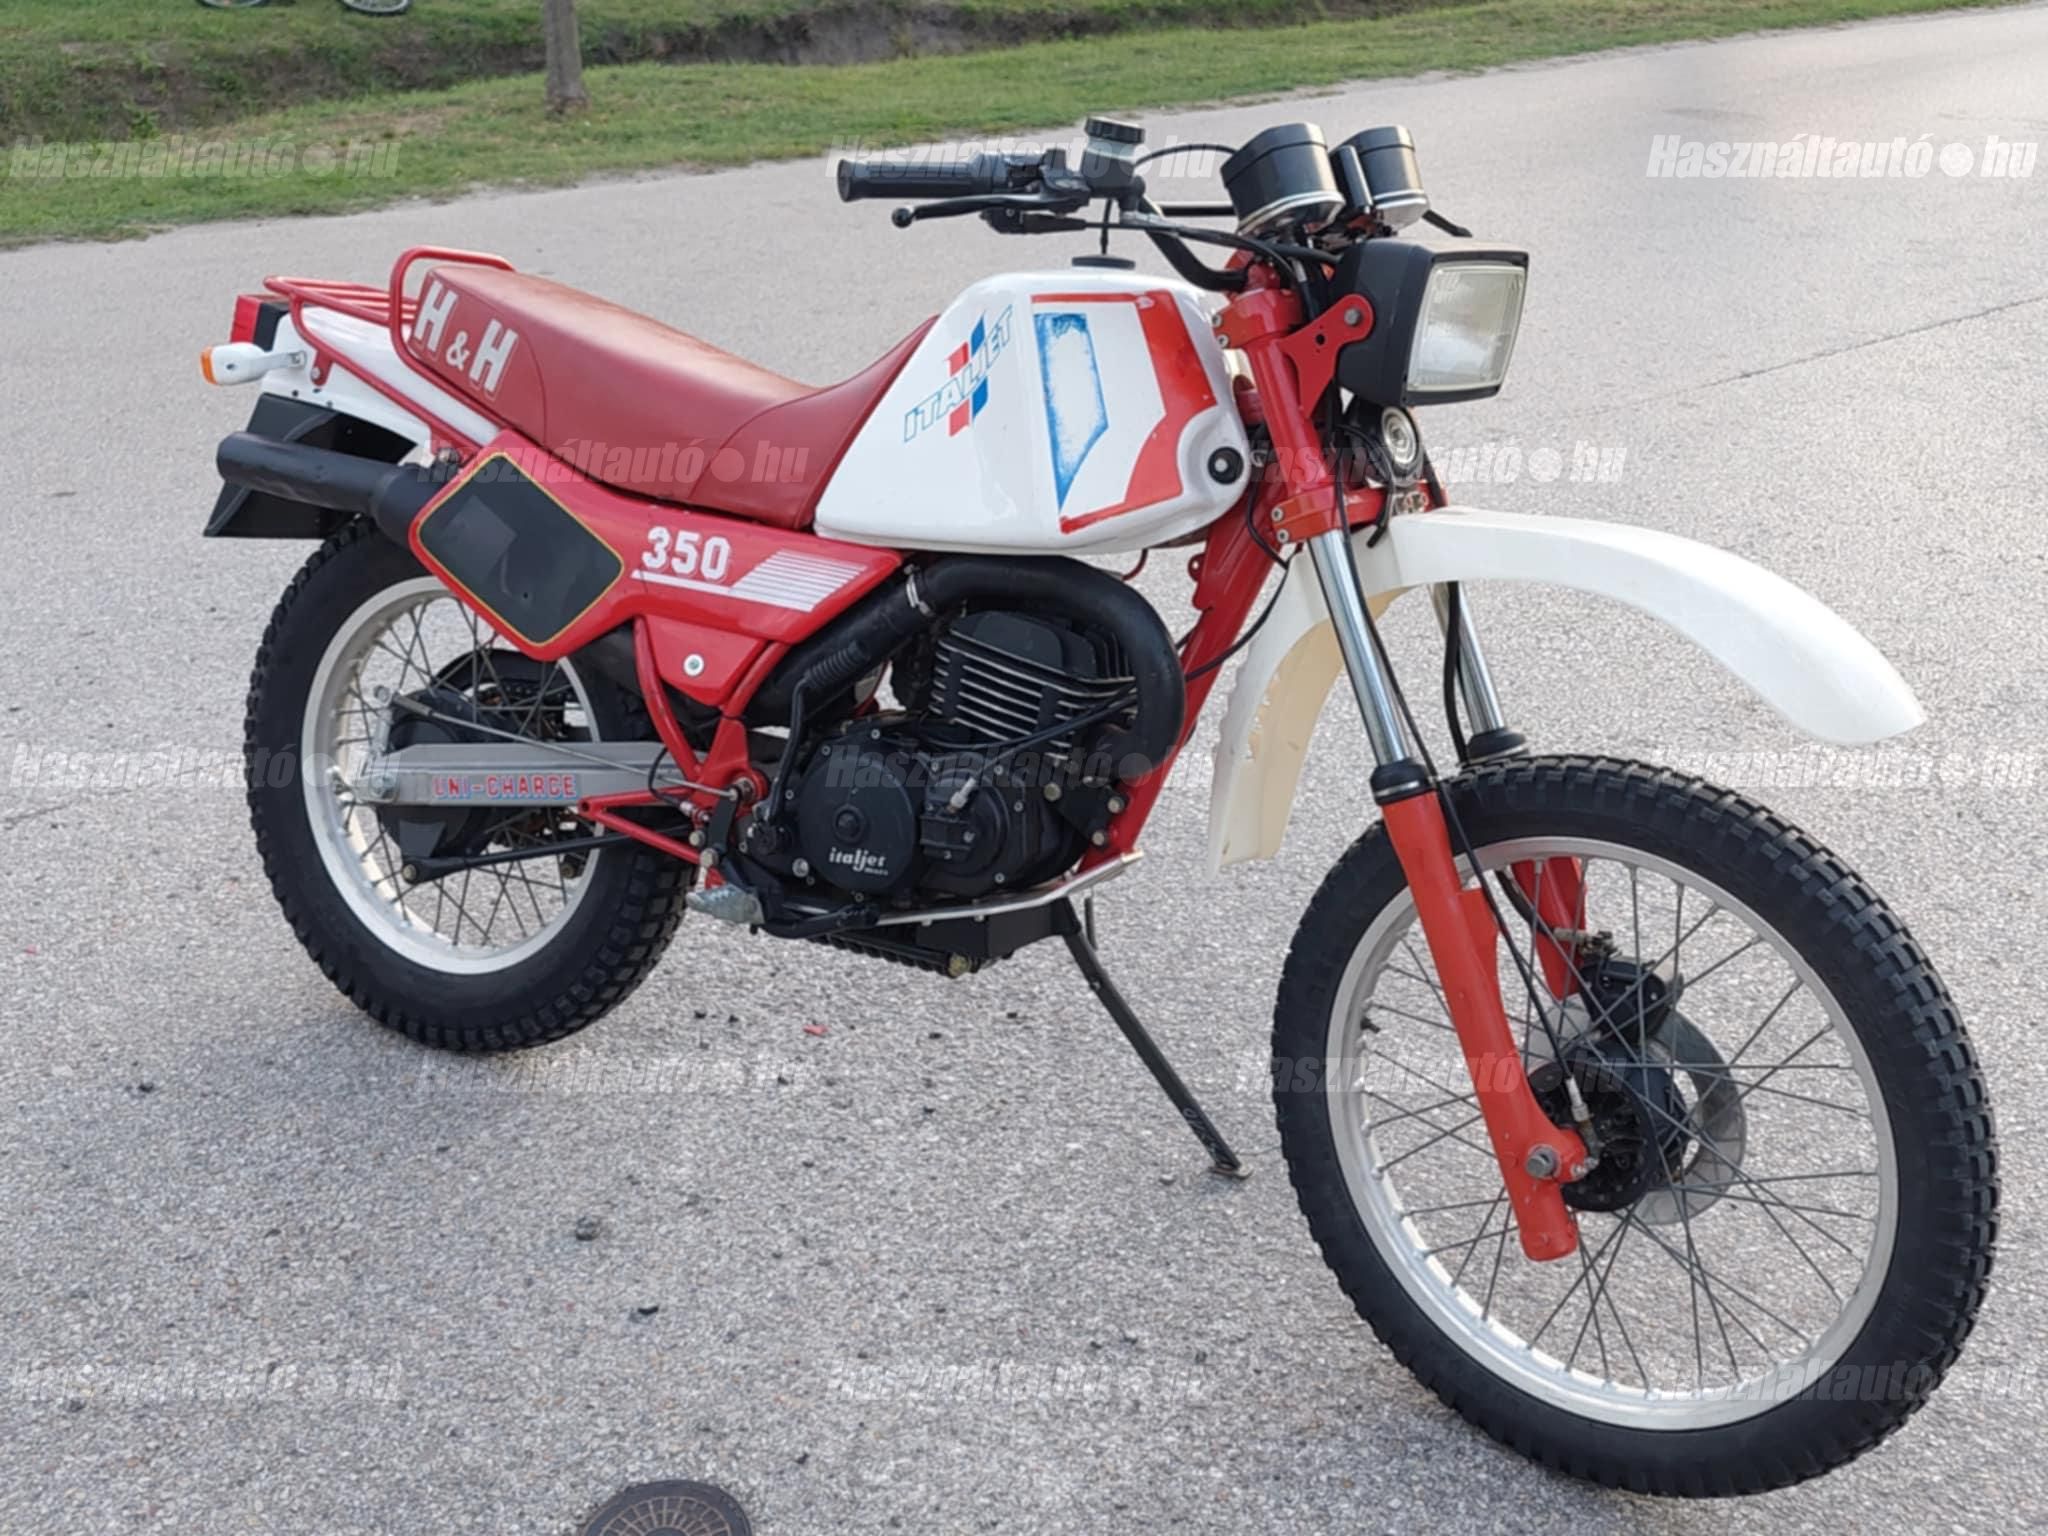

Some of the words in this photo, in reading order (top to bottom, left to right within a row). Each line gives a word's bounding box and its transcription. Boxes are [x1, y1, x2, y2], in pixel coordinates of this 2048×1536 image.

[414, 279, 458, 353] H
[446, 330, 470, 372] &
[469, 317, 518, 393] H
[904, 303, 1013, 443] ITALJET
[642, 526, 731, 580] 350
[432, 773, 579, 800] UNI-CHARGE
